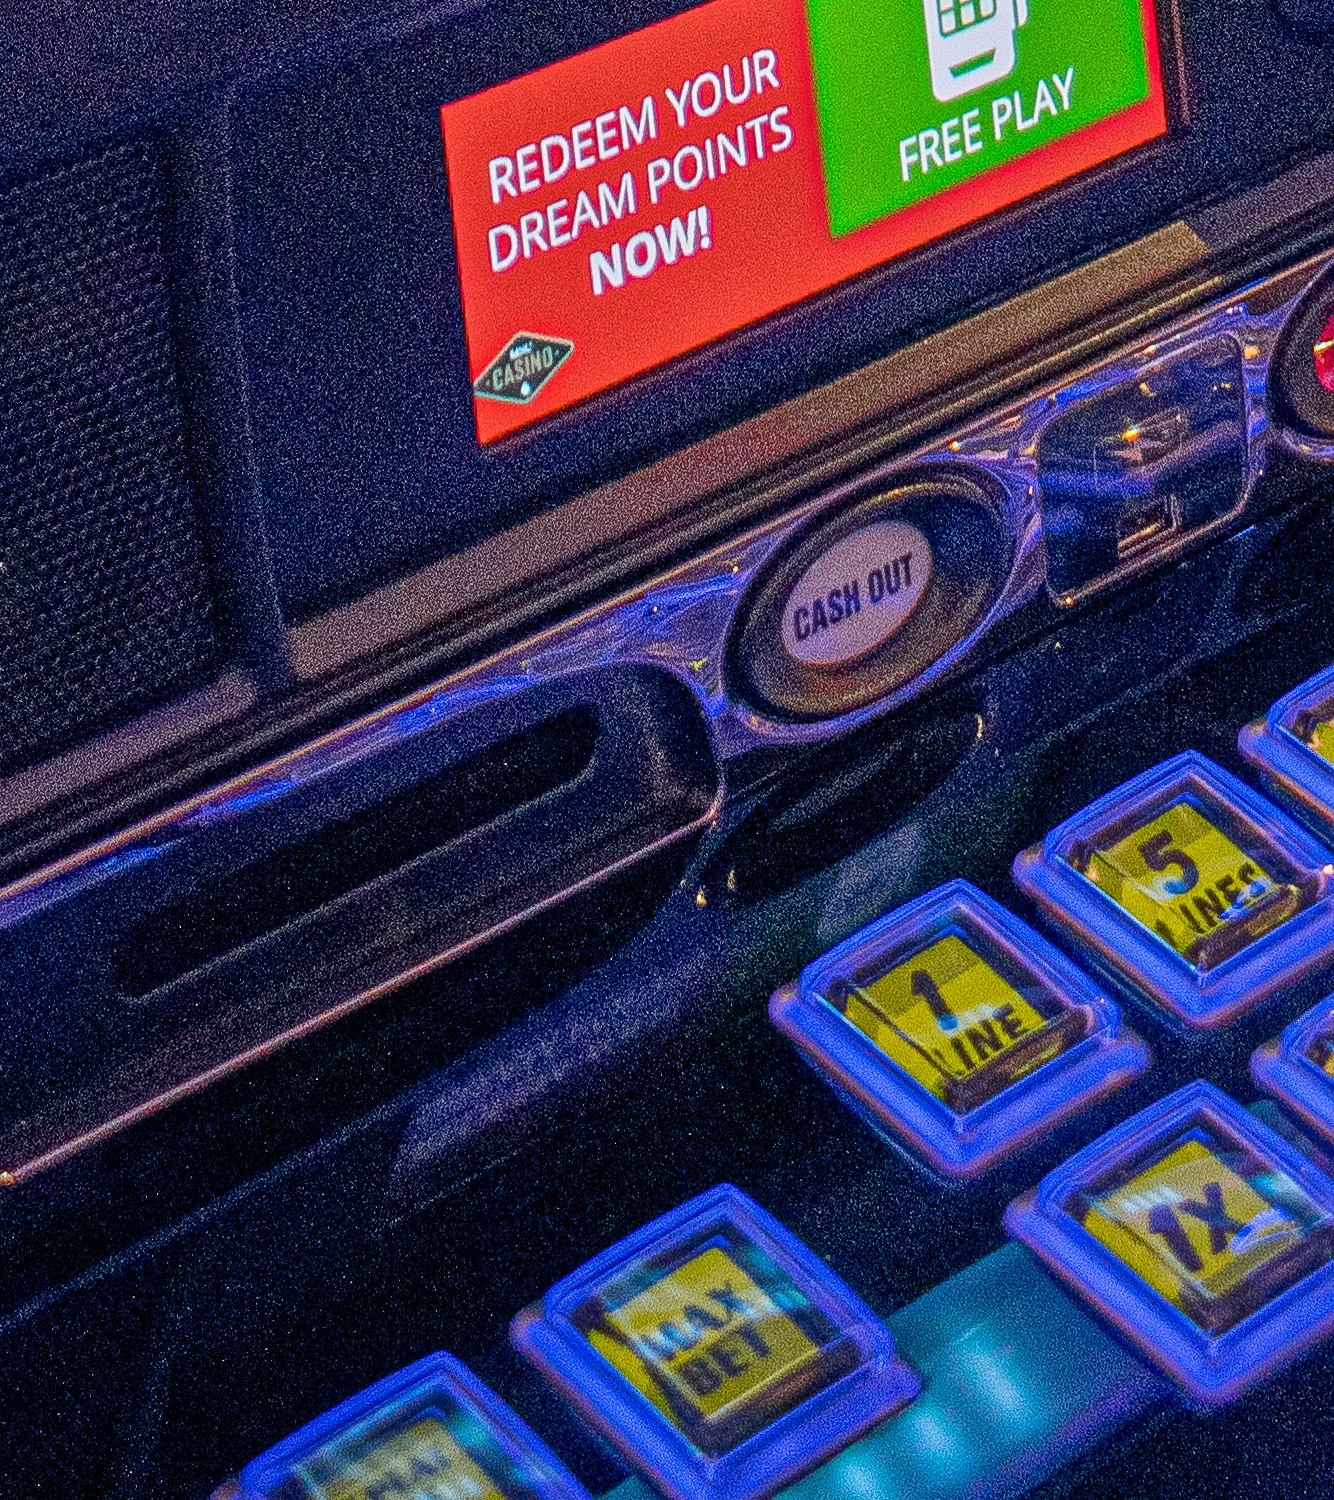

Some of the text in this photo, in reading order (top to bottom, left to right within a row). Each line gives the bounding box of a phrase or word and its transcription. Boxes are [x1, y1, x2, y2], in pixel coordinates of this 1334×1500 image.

[489, 47, 780, 203] REDEEM YOUR
[897, 67, 1075, 182] FREE PLAY
[486, 105, 794, 271] DREAM POINTS
[588, 205, 711, 296] NOW!
[492, 345, 554, 391] CASINO
[791, 551, 915, 642] CASH OUT
[1138, 829, 1200, 895] 5
[911, 970, 958, 1031] 1
[1149, 1182, 1245, 1272] 1X
[678, 1322, 770, 1396] BET
